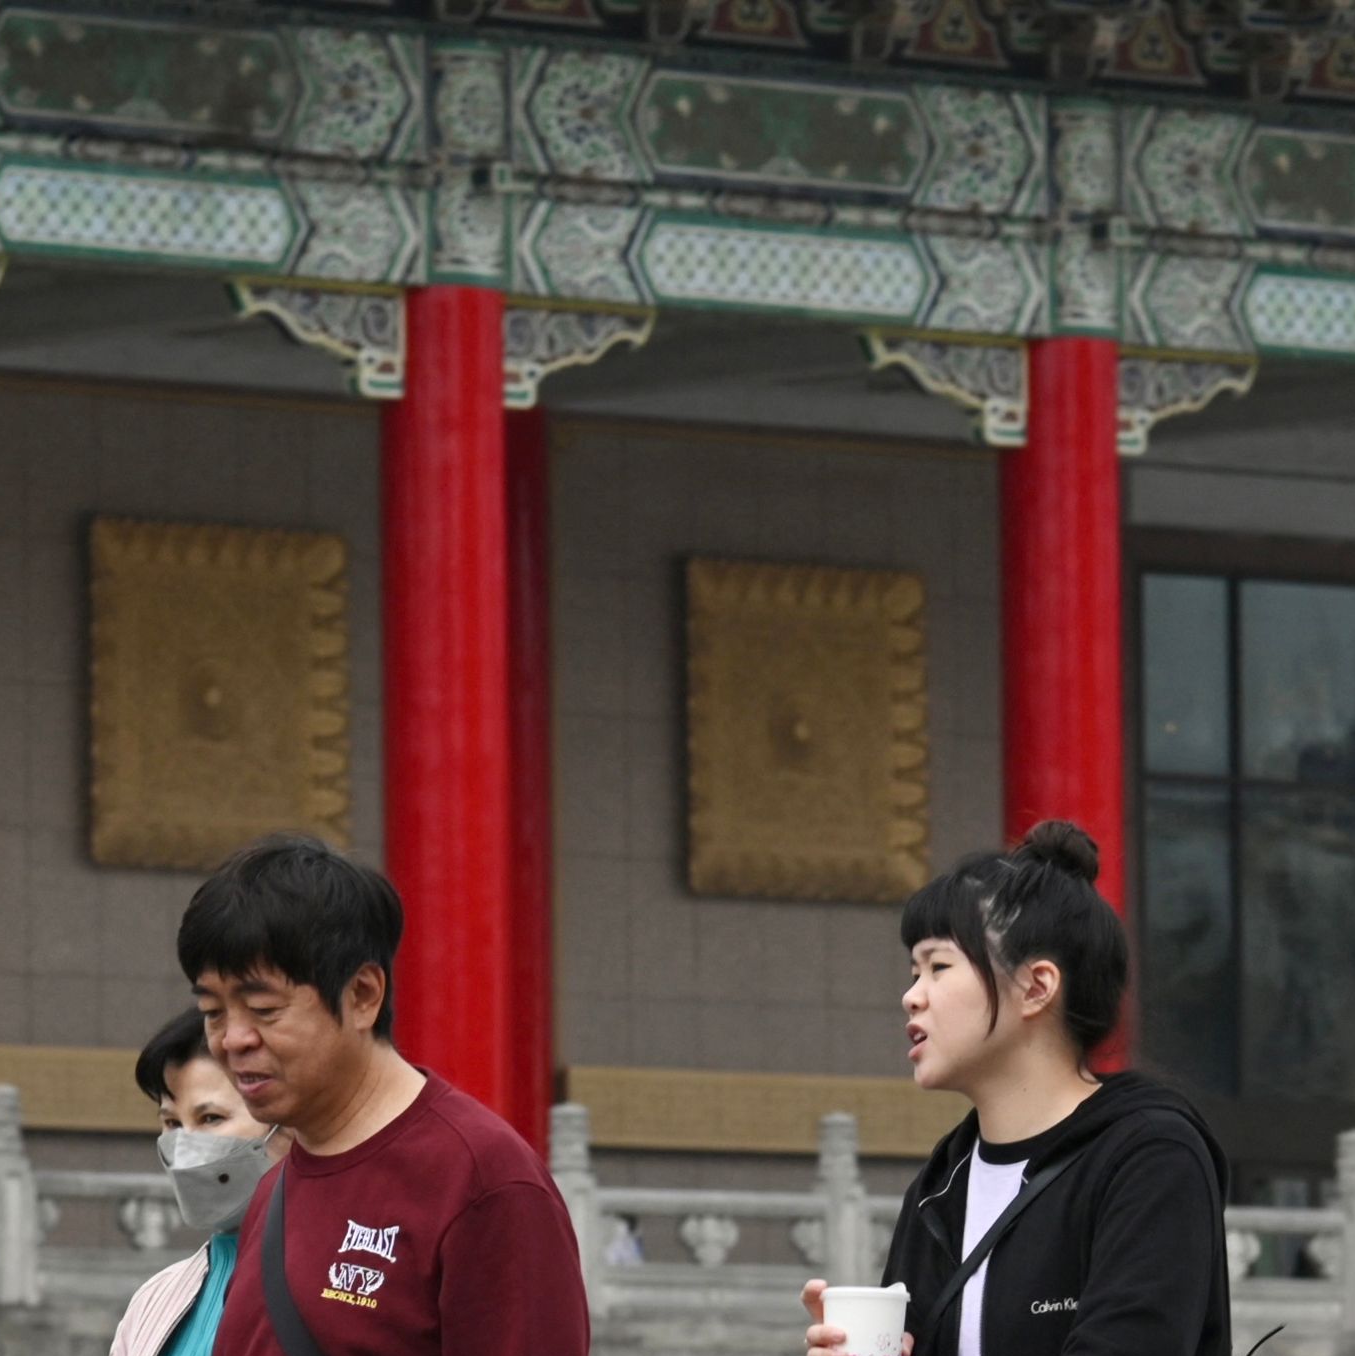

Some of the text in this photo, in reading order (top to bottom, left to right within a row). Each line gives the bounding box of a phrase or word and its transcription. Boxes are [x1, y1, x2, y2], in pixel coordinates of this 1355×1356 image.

[338, 1219, 400, 1263] EVERLAST
[335, 1263, 381, 1296] NY
[1030, 1297, 1079, 1315] Calvin Kle
